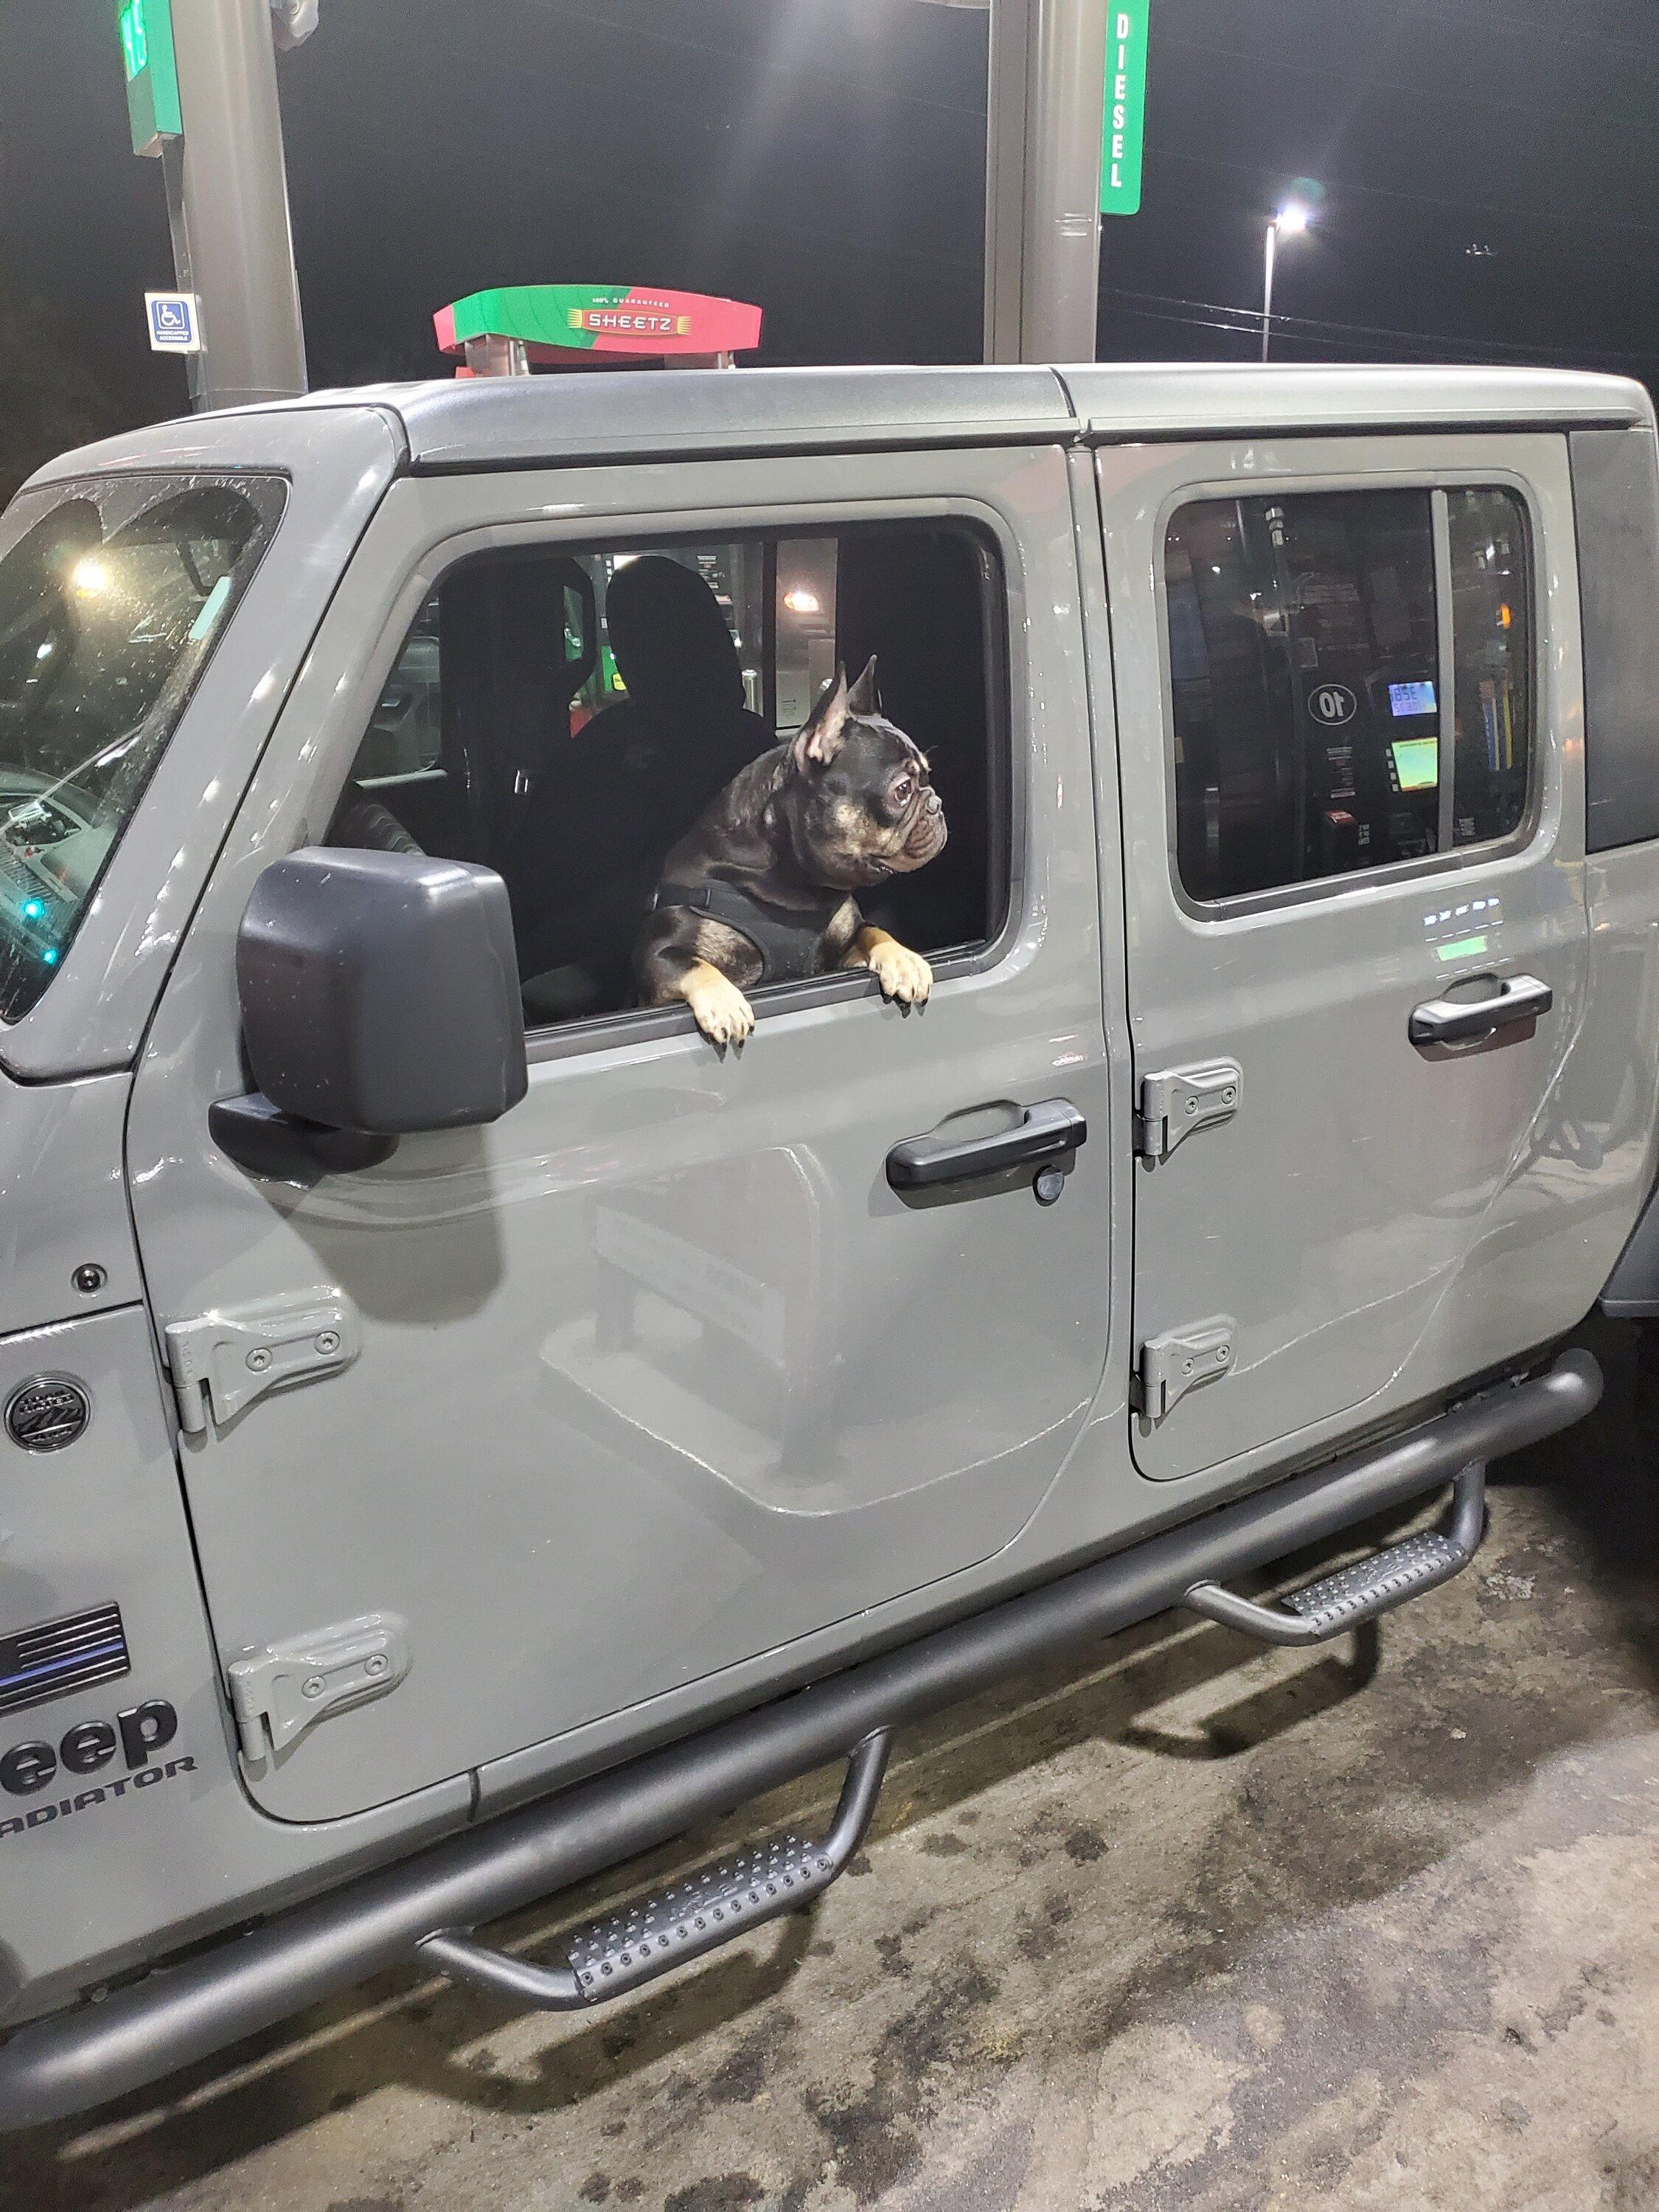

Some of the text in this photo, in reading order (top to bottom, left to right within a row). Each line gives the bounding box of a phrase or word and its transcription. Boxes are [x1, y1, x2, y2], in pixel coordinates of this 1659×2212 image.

[1110, 13, 1129, 187] DIESEL
[613, 298, 669, 308] GUARANTEED
[589, 313, 671, 330] SHEETZ
